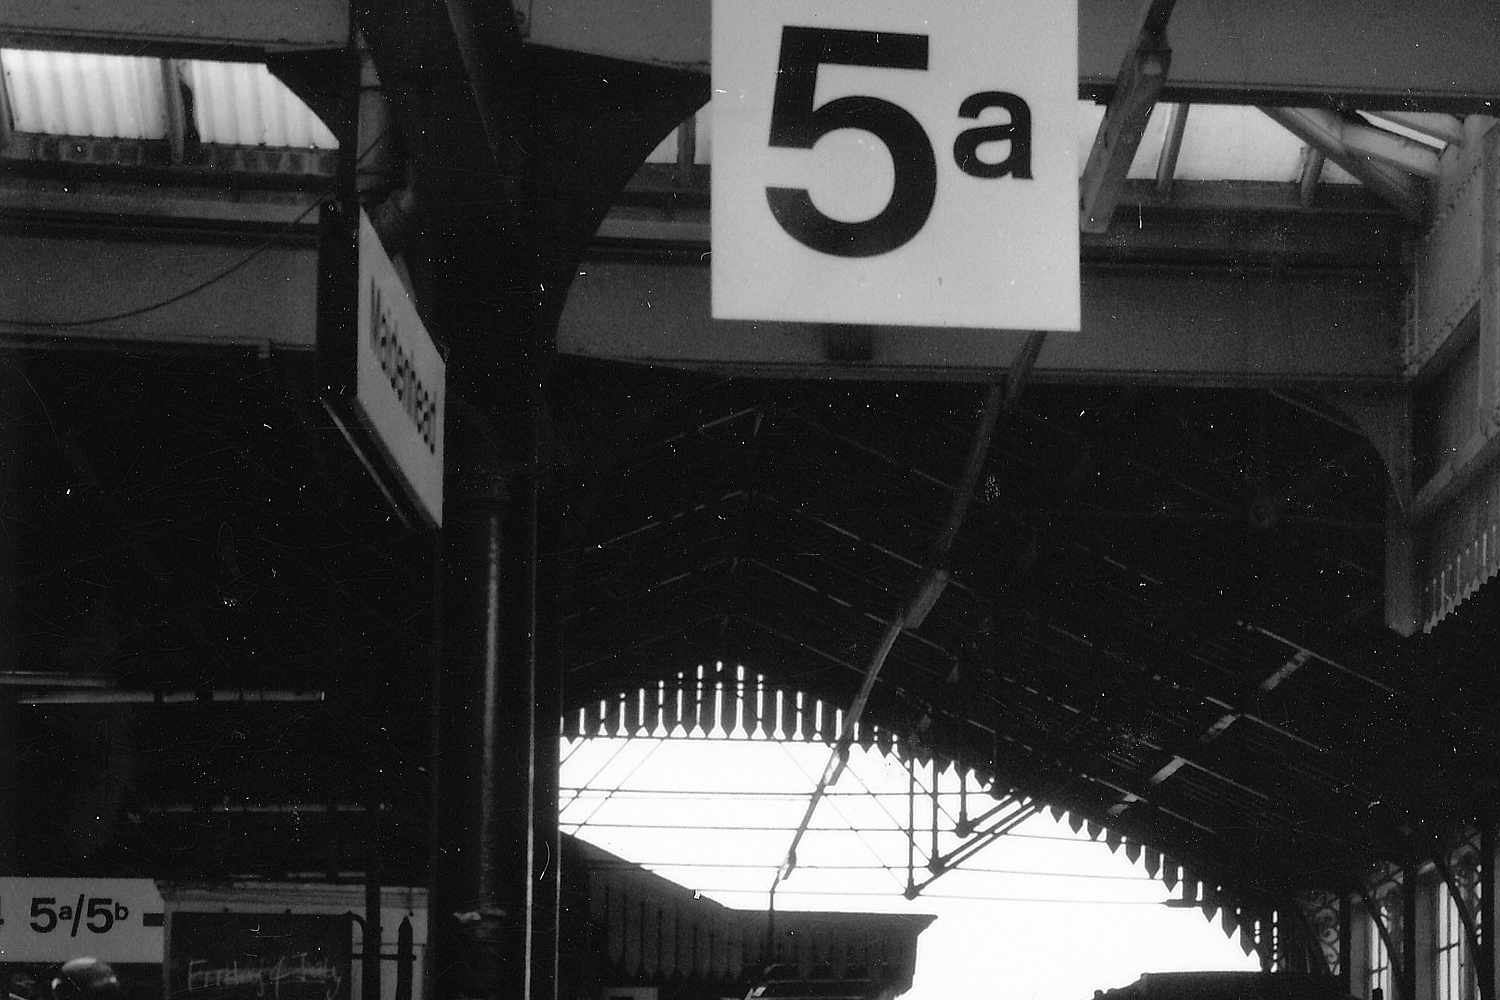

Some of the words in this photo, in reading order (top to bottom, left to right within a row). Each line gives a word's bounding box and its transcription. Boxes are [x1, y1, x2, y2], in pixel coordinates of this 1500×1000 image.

[765, 25, 1034, 259] 5a
[370, 274, 437, 456] Maidenhead
[29, 893, 130, 938] 5a/5b
